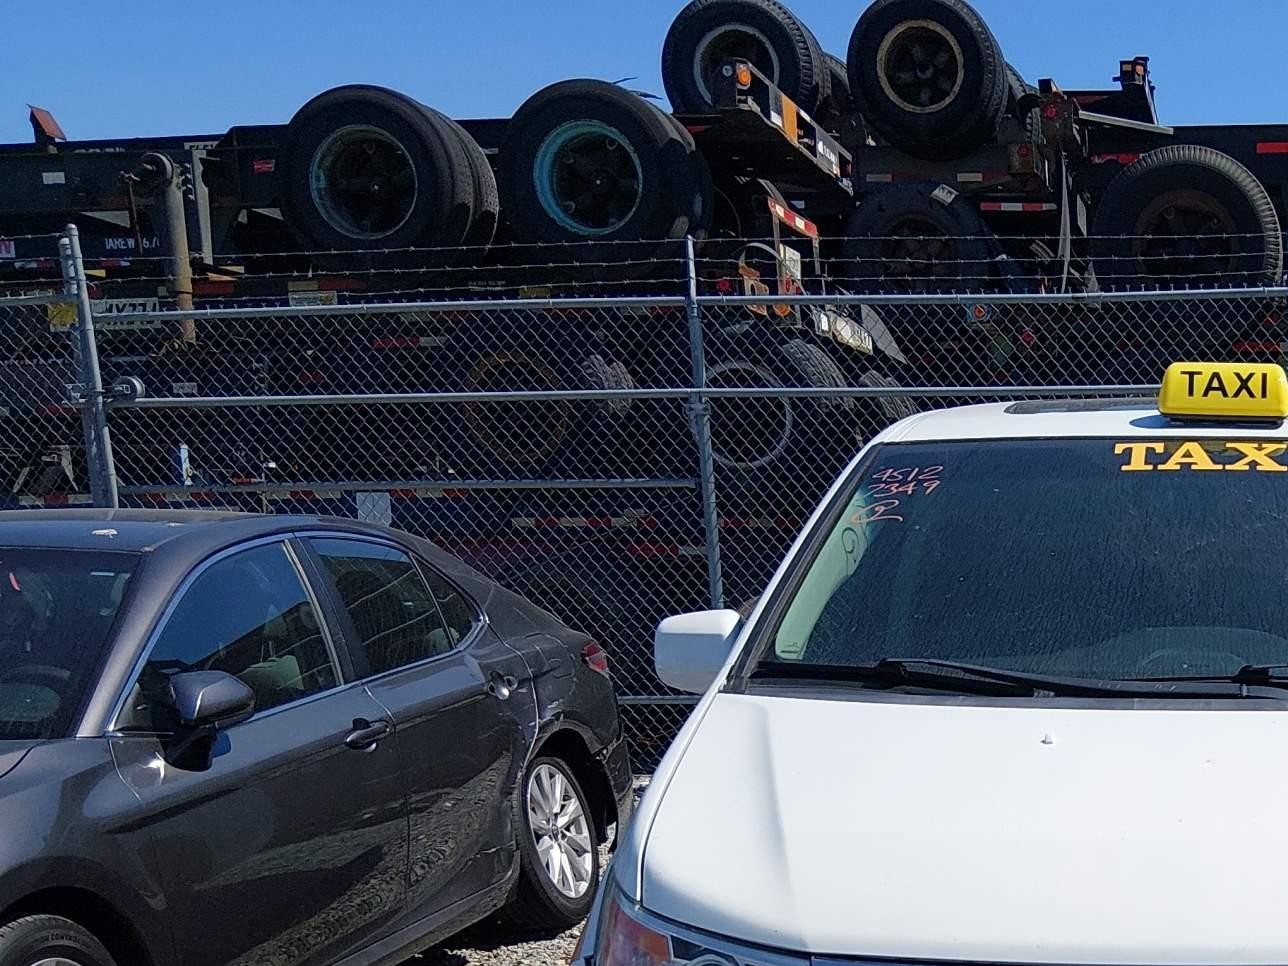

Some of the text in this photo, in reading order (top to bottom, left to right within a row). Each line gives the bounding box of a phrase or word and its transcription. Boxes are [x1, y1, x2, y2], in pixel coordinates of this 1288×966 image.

[1180, 370, 1268, 399] TAXI
[872, 466, 944, 481] 4512
[863, 480, 941, 497] 7349
